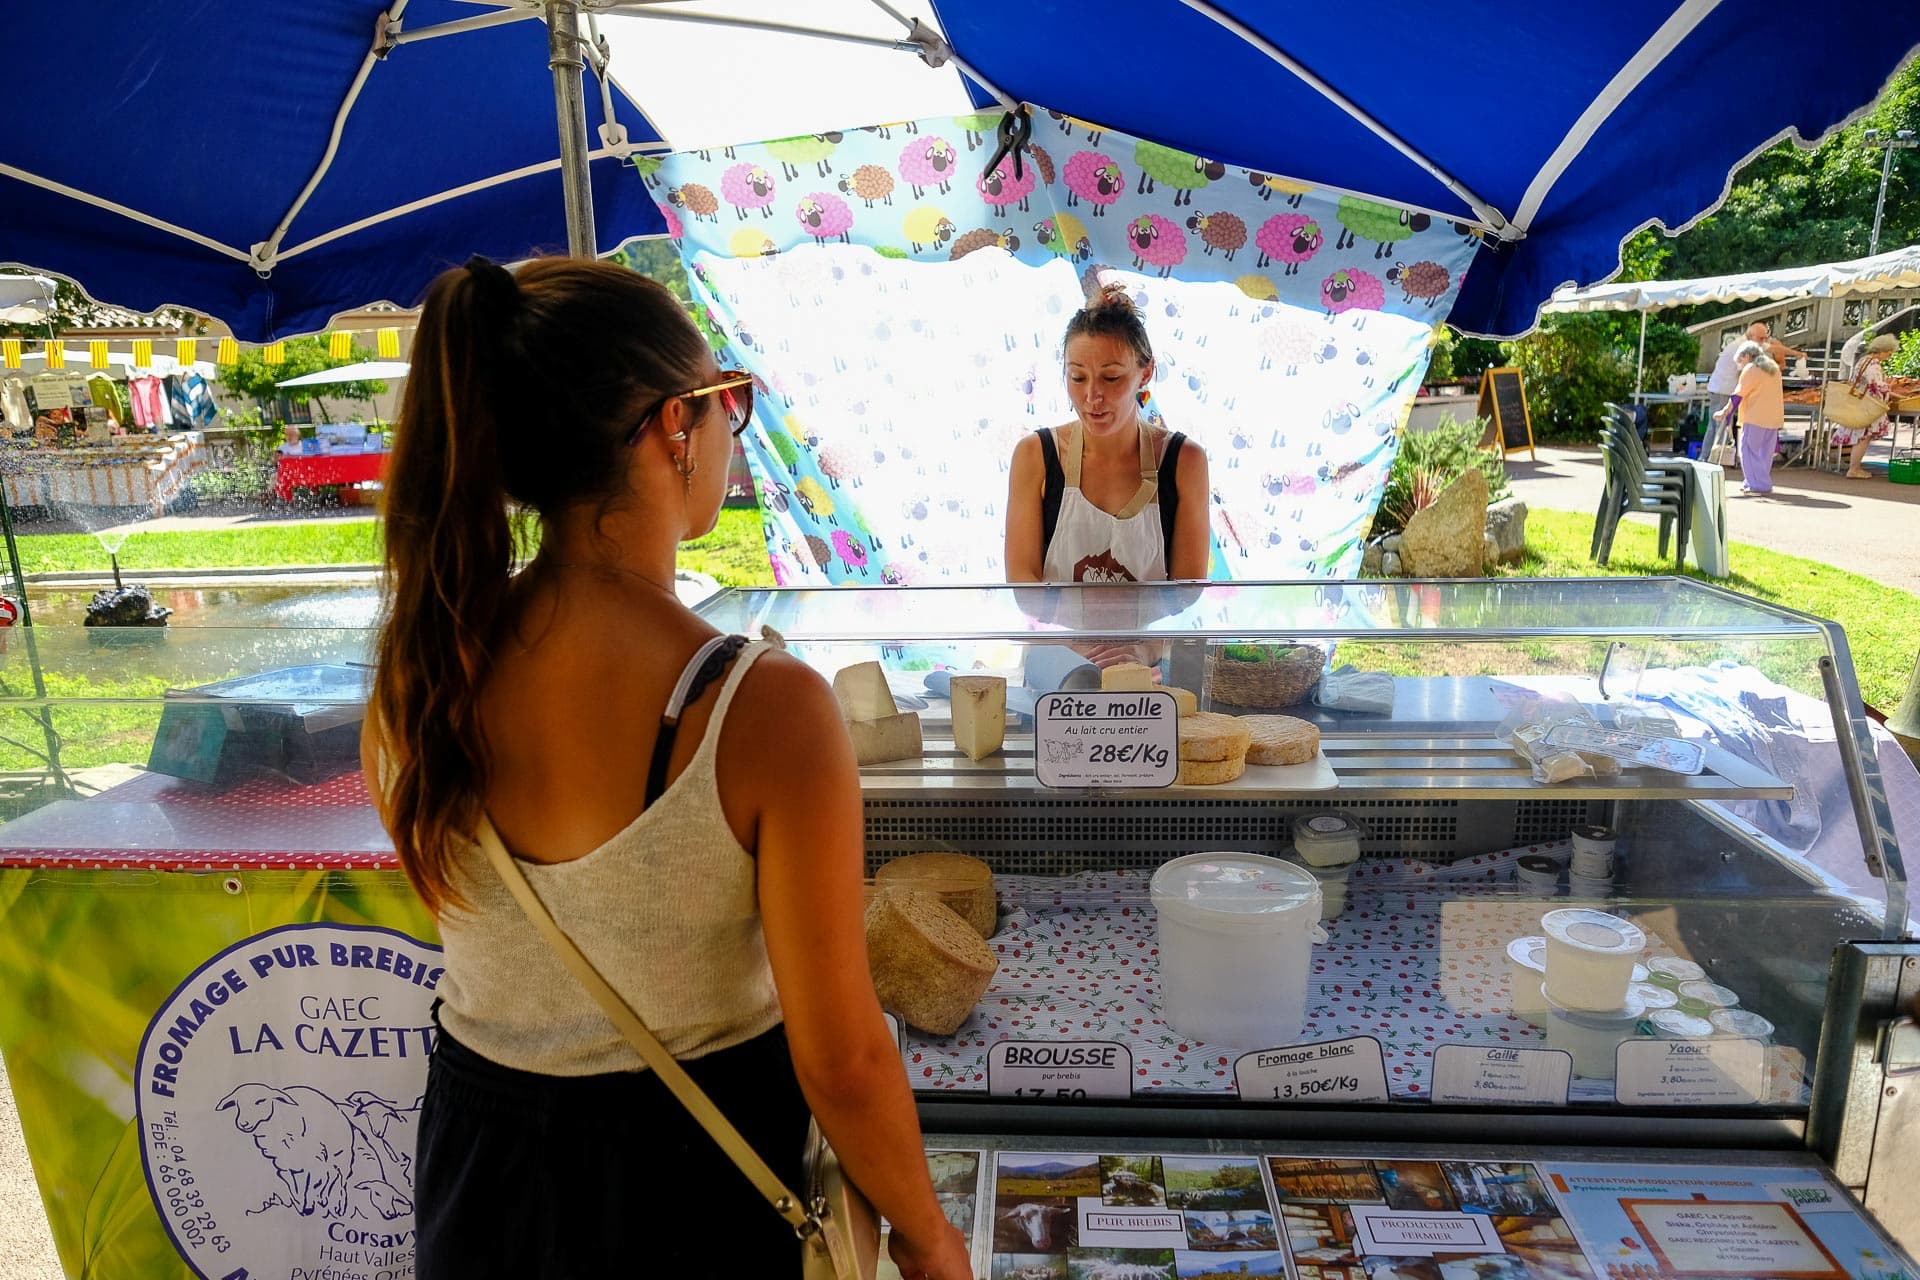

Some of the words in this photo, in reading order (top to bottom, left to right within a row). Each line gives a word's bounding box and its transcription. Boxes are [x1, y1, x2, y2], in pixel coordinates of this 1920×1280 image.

[1048, 697, 1096, 718] Pâte
[1107, 697, 1162, 718] molle
[1064, 726, 1078, 735] Au
[1080, 725, 1098, 735] lait
[1100, 727, 1116, 735] cru
[1118, 726, 1149, 735] entier
[1089, 744, 1169, 768] 28€/Kg
[300, 996, 382, 1022] GAEC
[151, 967, 248, 1098] FROMAGE
[249, 944, 320, 979] PUR
[330, 943, 445, 990] BREBIS
[229, 1023, 283, 1055] LA
[1005, 1046, 1117, 1066] BROUSSE
[1257, 1050, 1313, 1067] Fromage
[1320, 1044, 1354, 1058] blanc
[1487, 1049, 1519, 1060] Caillé
[1042, 1072, 1055, 1081] pur
[1057, 1071, 1081, 1080] brebis
[1273, 1076, 1358, 1100] 13,50€/Kg
[151, 1123, 168, 1149] EDE
[170, 1145, 187, 1163] 04
[159, 1165, 176, 1184] 66
[177, 1168, 194, 1186] 68
[167, 1187, 188, 1217] 060
[186, 1190, 204, 1208] 39
[197, 1212, 216, 1230] 29
[1097, 1217, 1124, 1226] PUR
[1128, 1218, 1172, 1227] BREBIS
[1381, 1219, 1464, 1230] PRODUCTEUR
[181, 1219, 206, 1250] 002
[211, 1235, 231, 1253] 63
[1401, 1231, 1453, 1241] FERMIER
[320, 1245, 360, 1264] Haut
